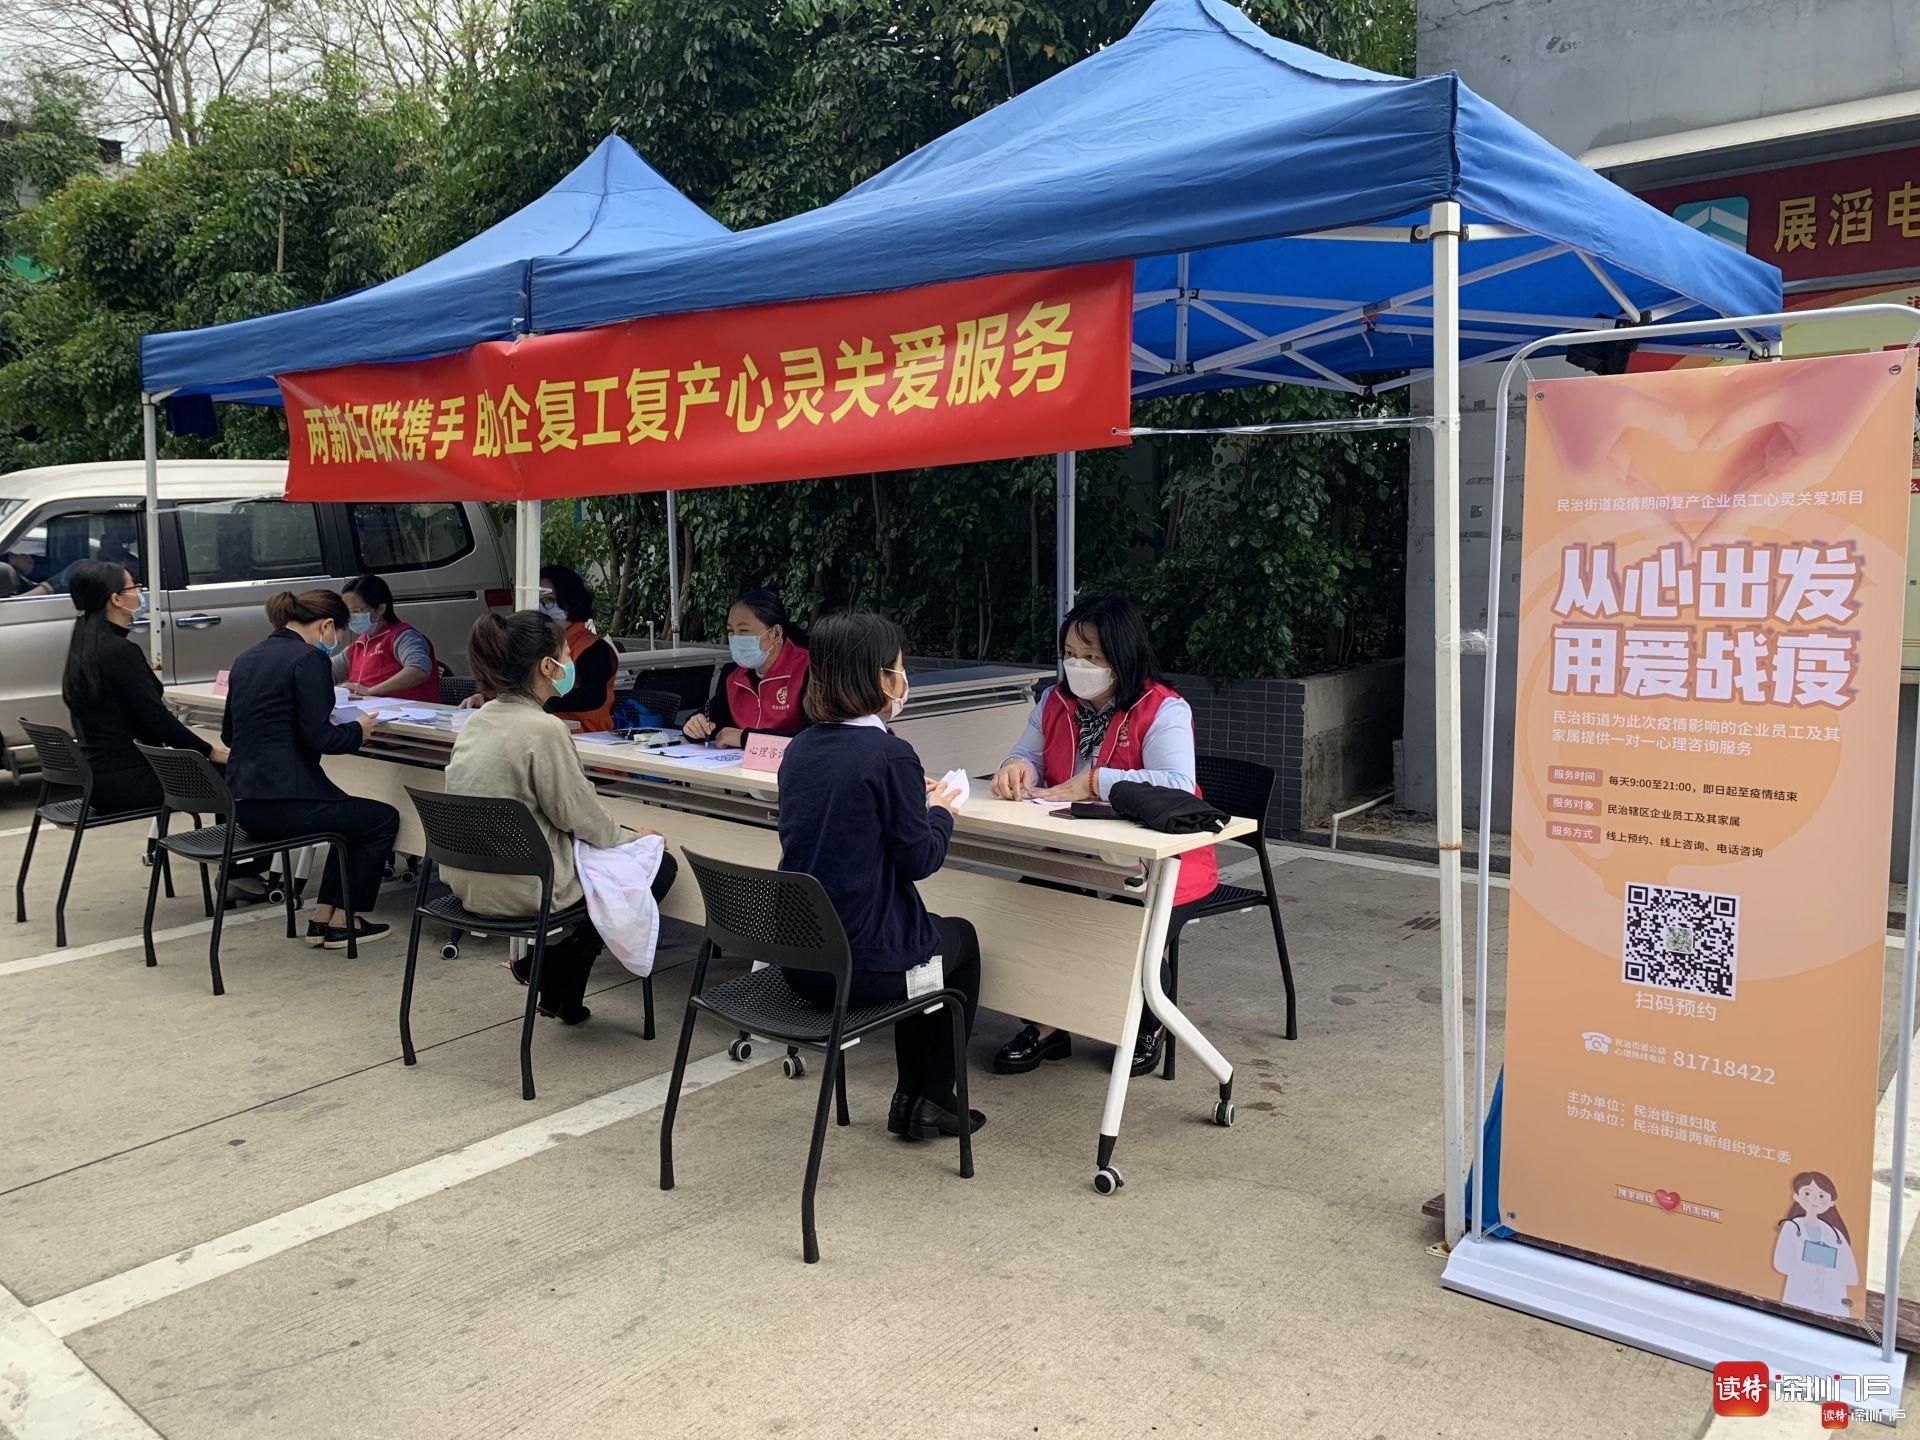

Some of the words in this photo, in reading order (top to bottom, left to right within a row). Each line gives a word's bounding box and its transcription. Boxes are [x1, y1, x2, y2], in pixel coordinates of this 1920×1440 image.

[303, 396, 465, 466] 两新妇联携手
[474, 300, 1074, 459] 助企复工复产心灵关爱服务
[1556, 490, 1864, 513] 民治街道疫情期间复产企业员工心灵关爱项目
[1553, 545, 1860, 624] 从心出发
[1551, 626, 1857, 707] 用爱战疫
[1552, 710, 1841, 743] 民治街道为此次疫情影响的企业员工及其
[1551, 728, 1753, 756] 家属提供一对一心理咨询服务
[1553, 769, 1596, 783] 服务时间
[1552, 797, 1595, 812] 服务对象
[1607, 804, 1741, 827] 民治辖区企业员工及其家属
[1551, 825, 1594, 840] 服务方式
[1634, 991, 1718, 1022] 扫码预约
[1672, 1050, 1776, 1085] 81718422
[1633, 1104, 1719, 1133] 民治街道妇联
[1633, 1119, 1792, 1165] 民治街道两新组织党工委
